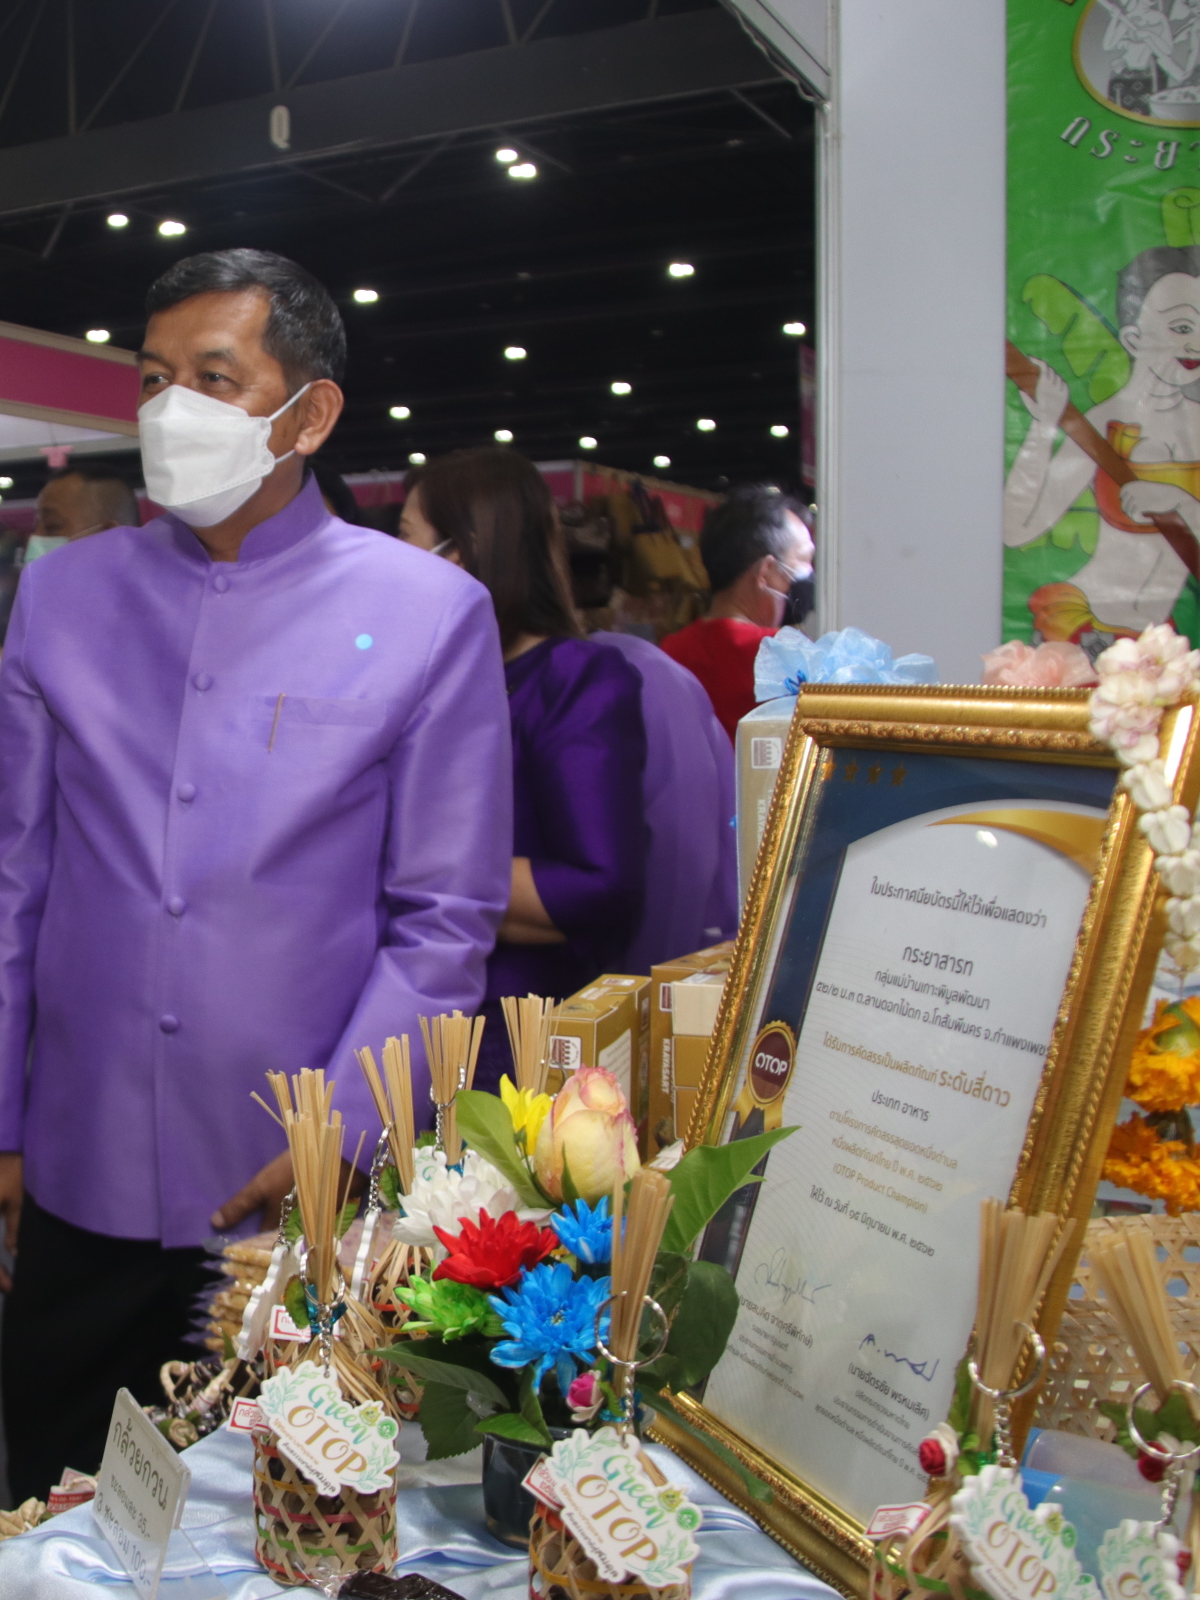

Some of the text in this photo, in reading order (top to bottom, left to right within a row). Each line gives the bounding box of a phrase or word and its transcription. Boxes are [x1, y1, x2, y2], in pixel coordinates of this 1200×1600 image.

[870, 876, 1047, 928] ใบประกาศนียบัตรนี้ให้ไว้เพื่อแสดงว่า
[902, 946, 974, 976] กระยาสารท
[660, 1038, 671, 1093] KRAYASART
[755, 1052, 788, 1077] OTOP
[938, 1069, 1011, 1107] ระดับสี่ดาว
[871, 1089, 929, 1122] ประเภท อาหาร
[833, 1162, 928, 1214] (OTOP Product Champion)
[287, 1405, 367, 1474] OTOP
[308, 1383, 372, 1445] Green
[113, 1417, 169, 1511] กล้วยกวน
[603, 1455, 669, 1529] Green
[576, 1474, 658, 1561] OTOP
[1002, 1491, 1055, 1560] Green
[988, 1521, 1057, 1598] OTOP
